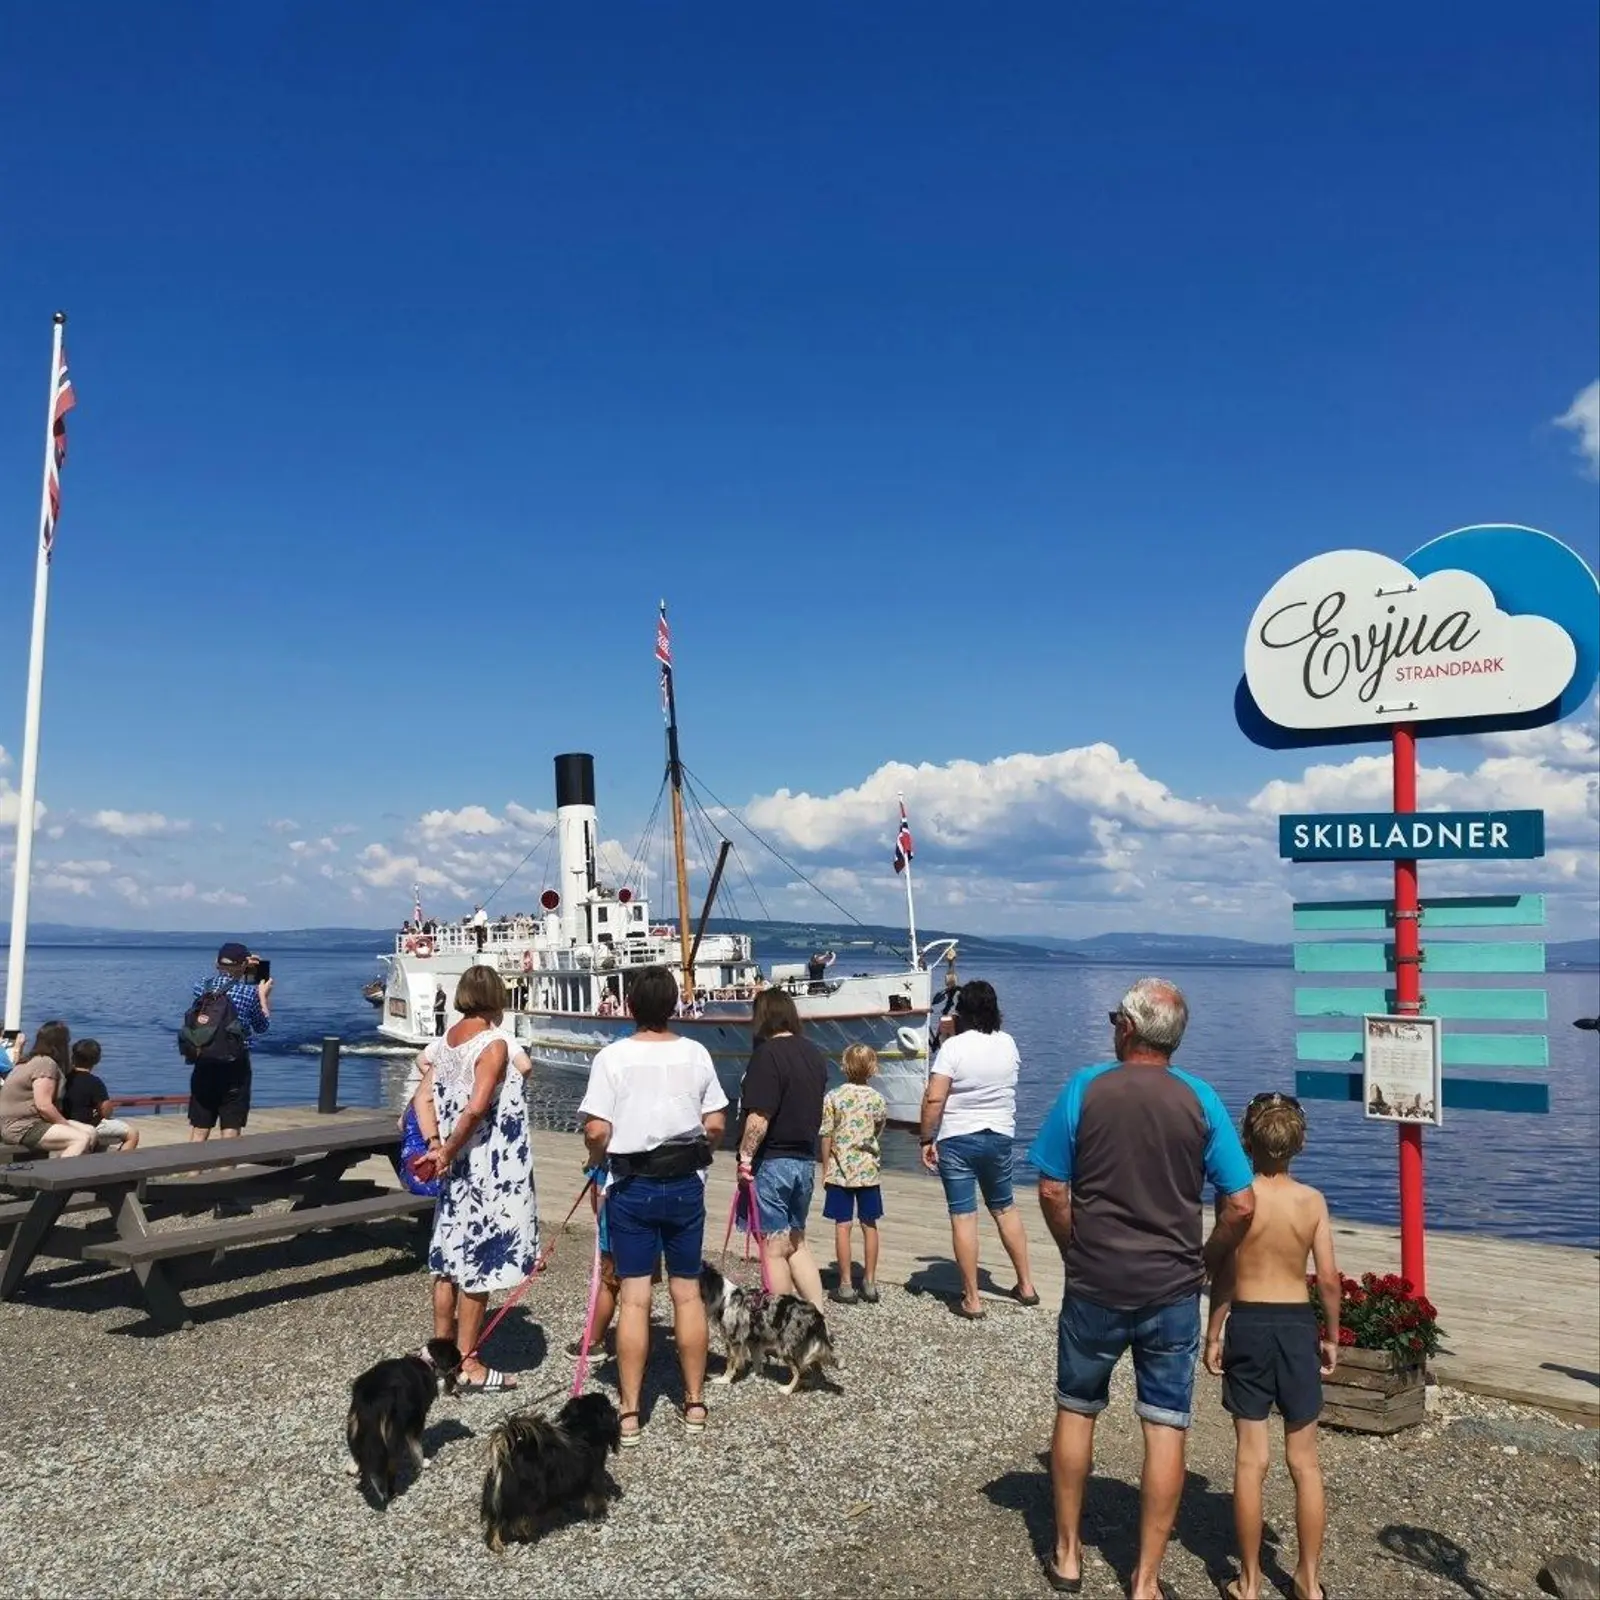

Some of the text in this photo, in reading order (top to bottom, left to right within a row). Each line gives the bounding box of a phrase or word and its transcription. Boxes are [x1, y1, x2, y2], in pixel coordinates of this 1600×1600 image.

[1260, 591, 1481, 703] Evjua
[1395, 657, 1505, 682] STRANDPARK
[1294, 822, 1510, 849] SKIBLADNER
